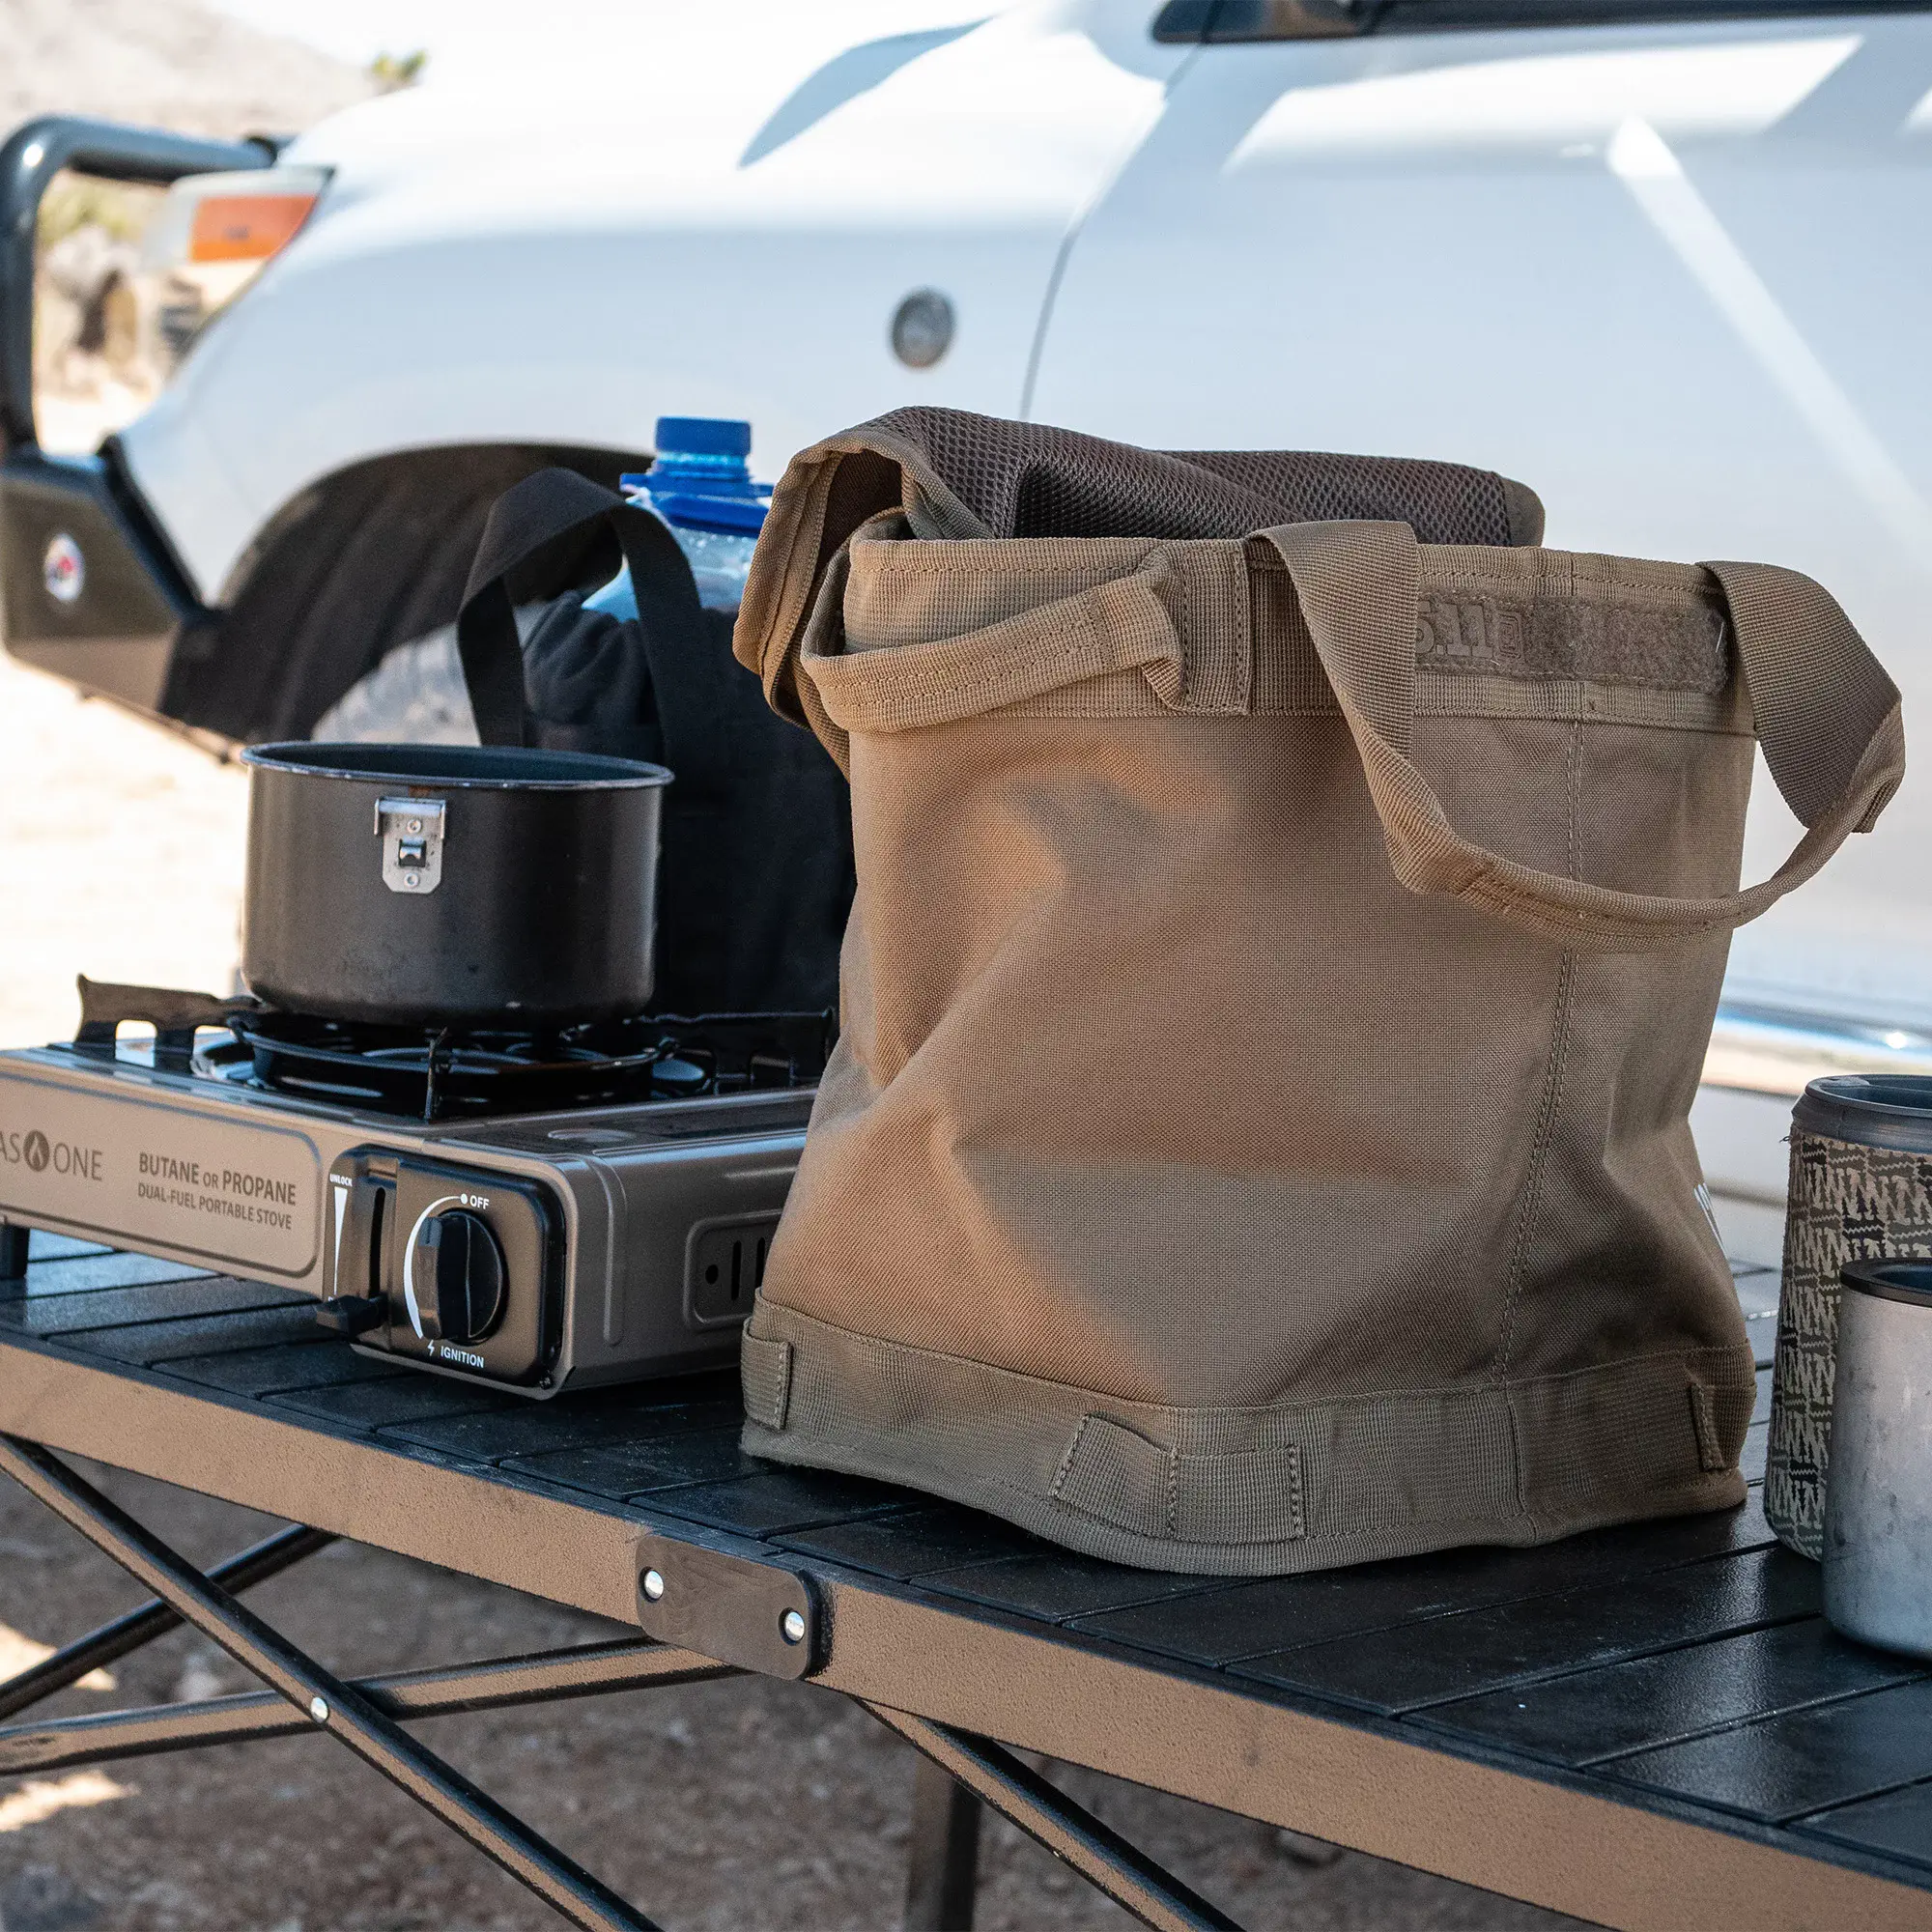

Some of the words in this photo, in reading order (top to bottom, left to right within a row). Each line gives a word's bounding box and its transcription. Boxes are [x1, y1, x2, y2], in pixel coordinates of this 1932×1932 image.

[53, 1142, 102, 1181] ONE
[138, 1151, 199, 1185] BUTANE
[202, 1172, 218, 1189] OR
[222, 1170, 297, 1207] PROPANE
[329, 1173, 354, 1187] UNLOCK
[137, 1182, 196, 1209] DUAL-FUEL
[198, 1195, 254, 1222] PORTABLE
[256, 1208, 293, 1231] STOVE
[469, 1194, 490, 1209] OFF
[440, 1345, 485, 1369] IGNITION
